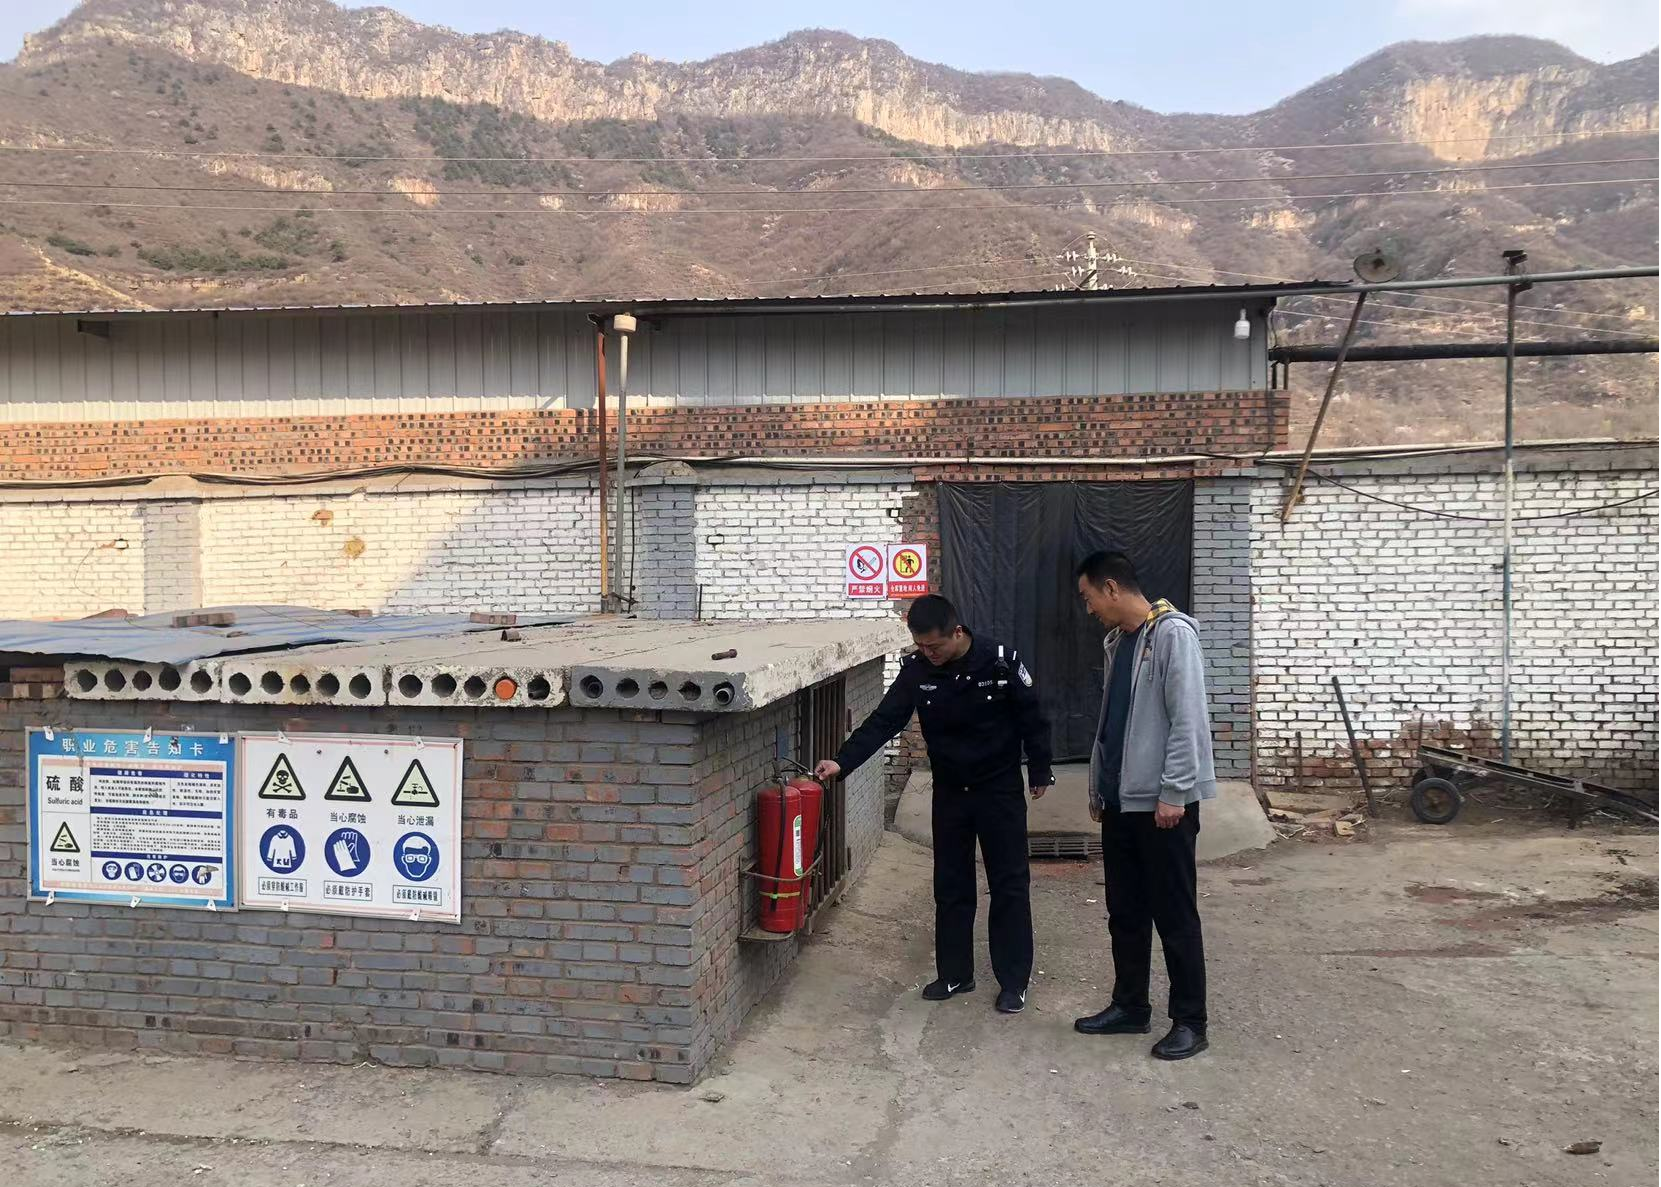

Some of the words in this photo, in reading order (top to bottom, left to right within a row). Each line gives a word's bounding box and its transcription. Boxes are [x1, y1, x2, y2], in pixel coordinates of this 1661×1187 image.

[851, 585, 881, 594] 严禁烟火
[62, 738, 204, 756] 职业危害告知卡
[46, 775, 84, 793] 硫酸
[47, 797, 70, 805] Sulfuric
[70, 798, 83, 806] acid
[266, 808, 298, 820] 有毒品
[330, 812, 367, 824] 当心腐蚀
[397, 814, 435, 827] 当心泄漏
[51, 858, 80, 867] 当心腐蚀
[325, 884, 371, 898] 必须戴防护手套
